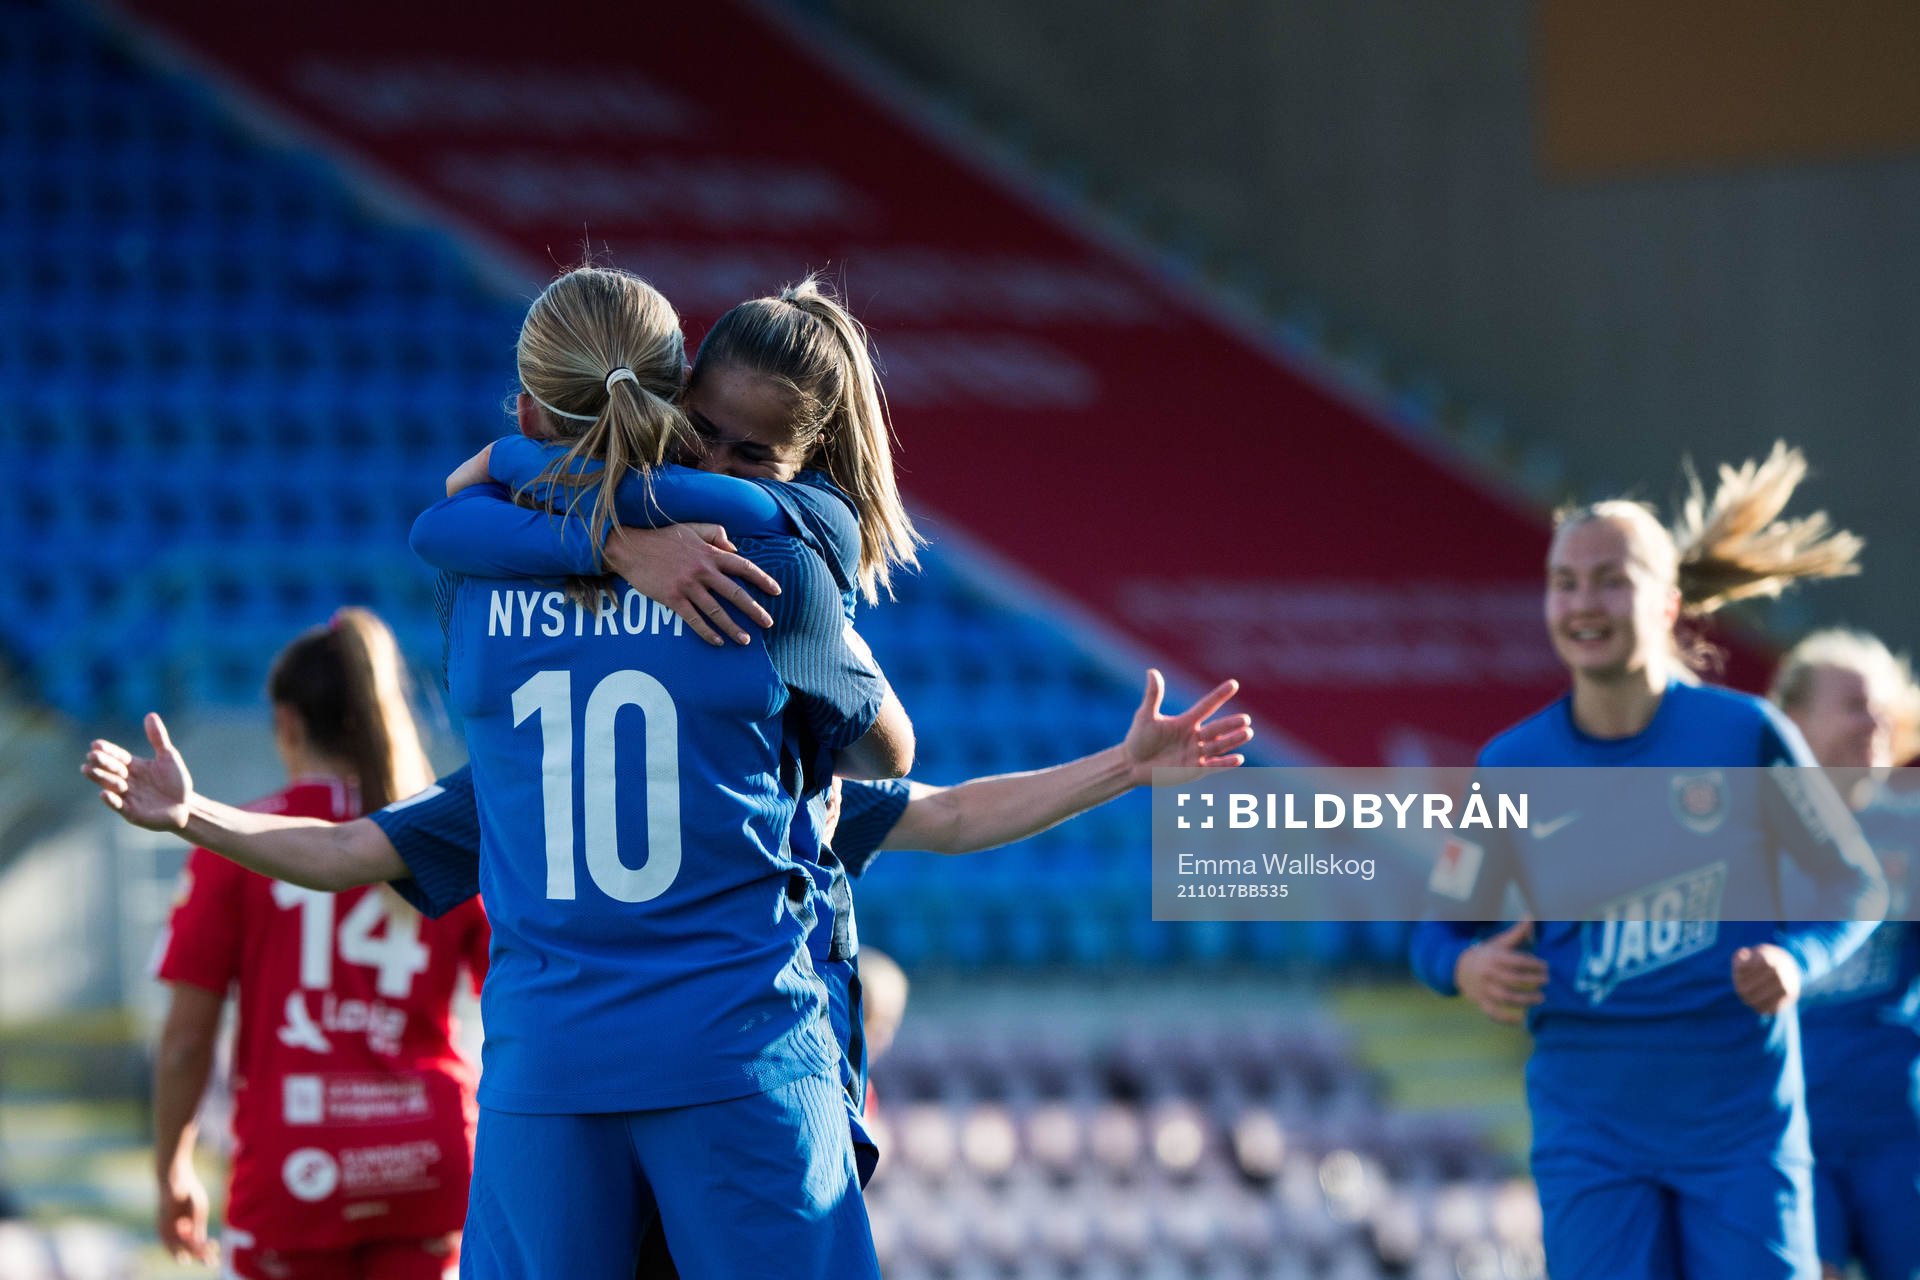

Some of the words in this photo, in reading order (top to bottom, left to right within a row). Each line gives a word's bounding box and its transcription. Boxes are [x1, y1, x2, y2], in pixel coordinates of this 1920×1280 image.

[511, 669, 682, 903] 10
[271, 879, 430, 999] 14
[1588, 888, 1683, 976] JAG
